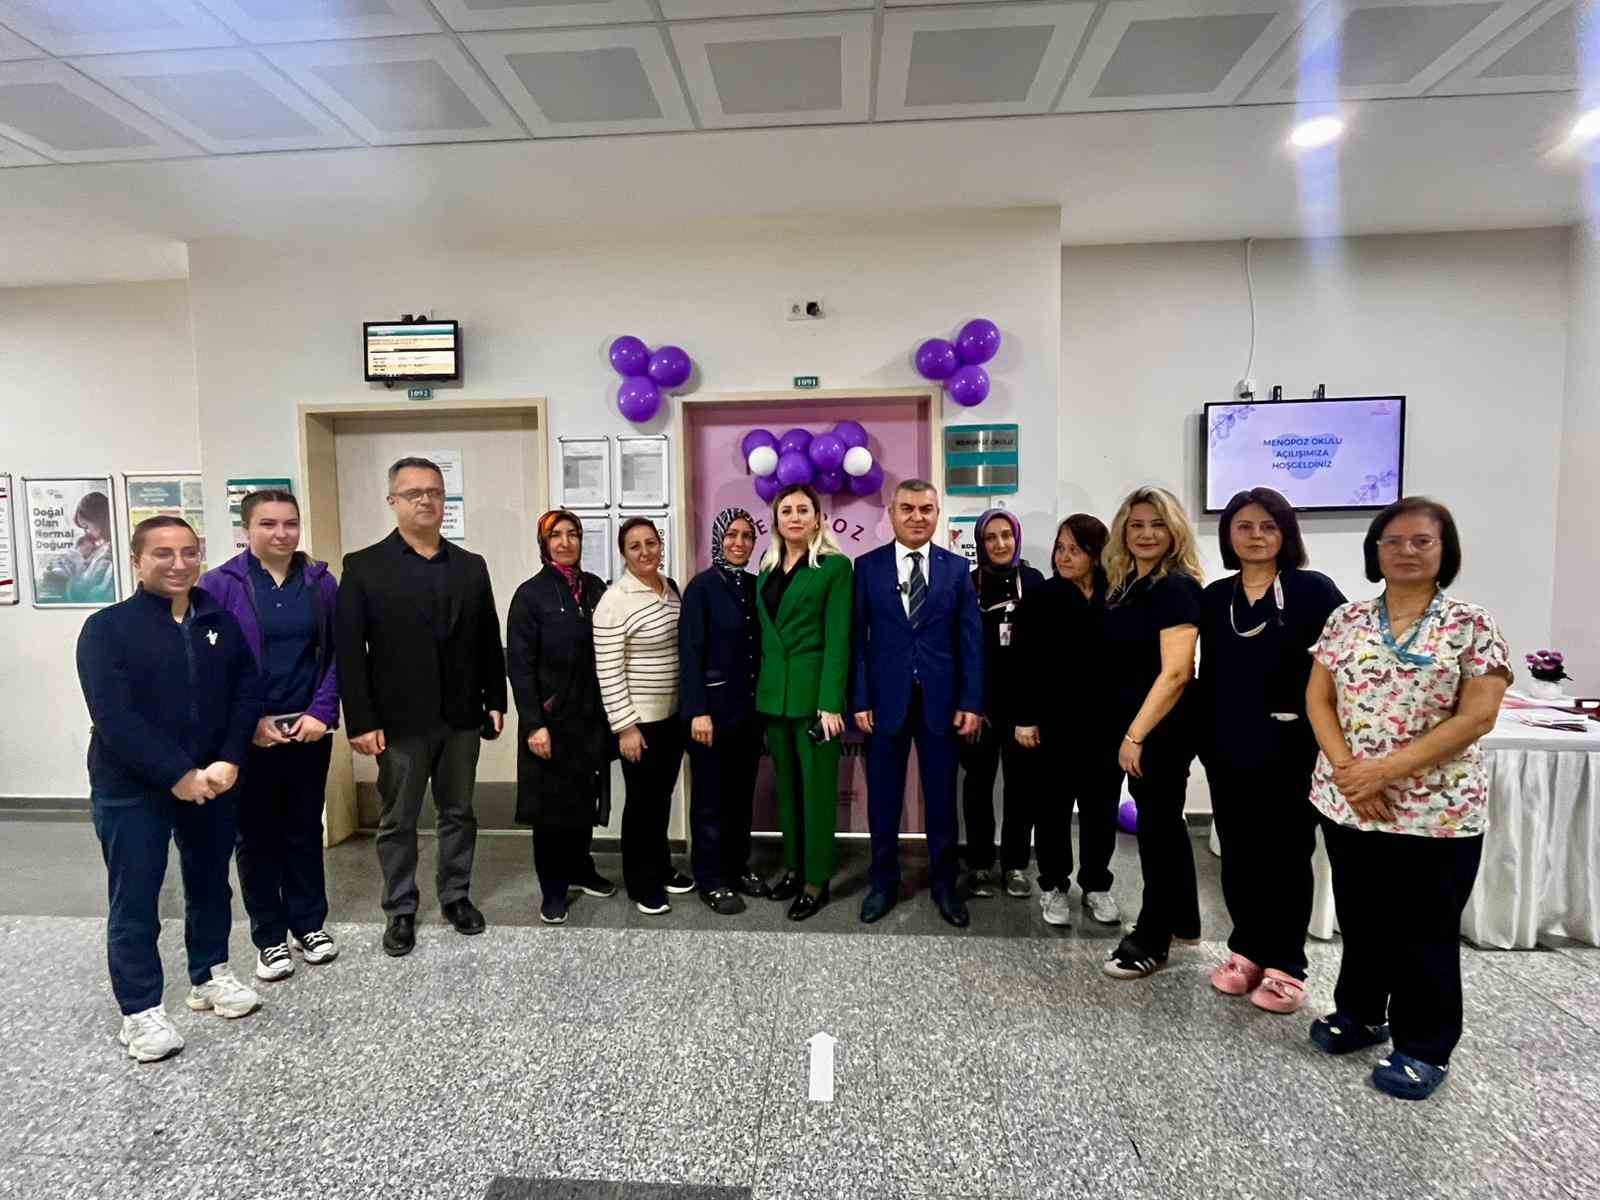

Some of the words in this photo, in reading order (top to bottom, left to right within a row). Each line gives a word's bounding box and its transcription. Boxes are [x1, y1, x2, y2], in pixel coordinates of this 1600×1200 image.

[1263, 438, 1309, 446] MENOPOZ
[1311, 437, 1343, 446] OKULU
[33, 506, 64, 519] Doğal
[34, 518, 59, 528] Olan
[35, 528, 75, 538] Normal
